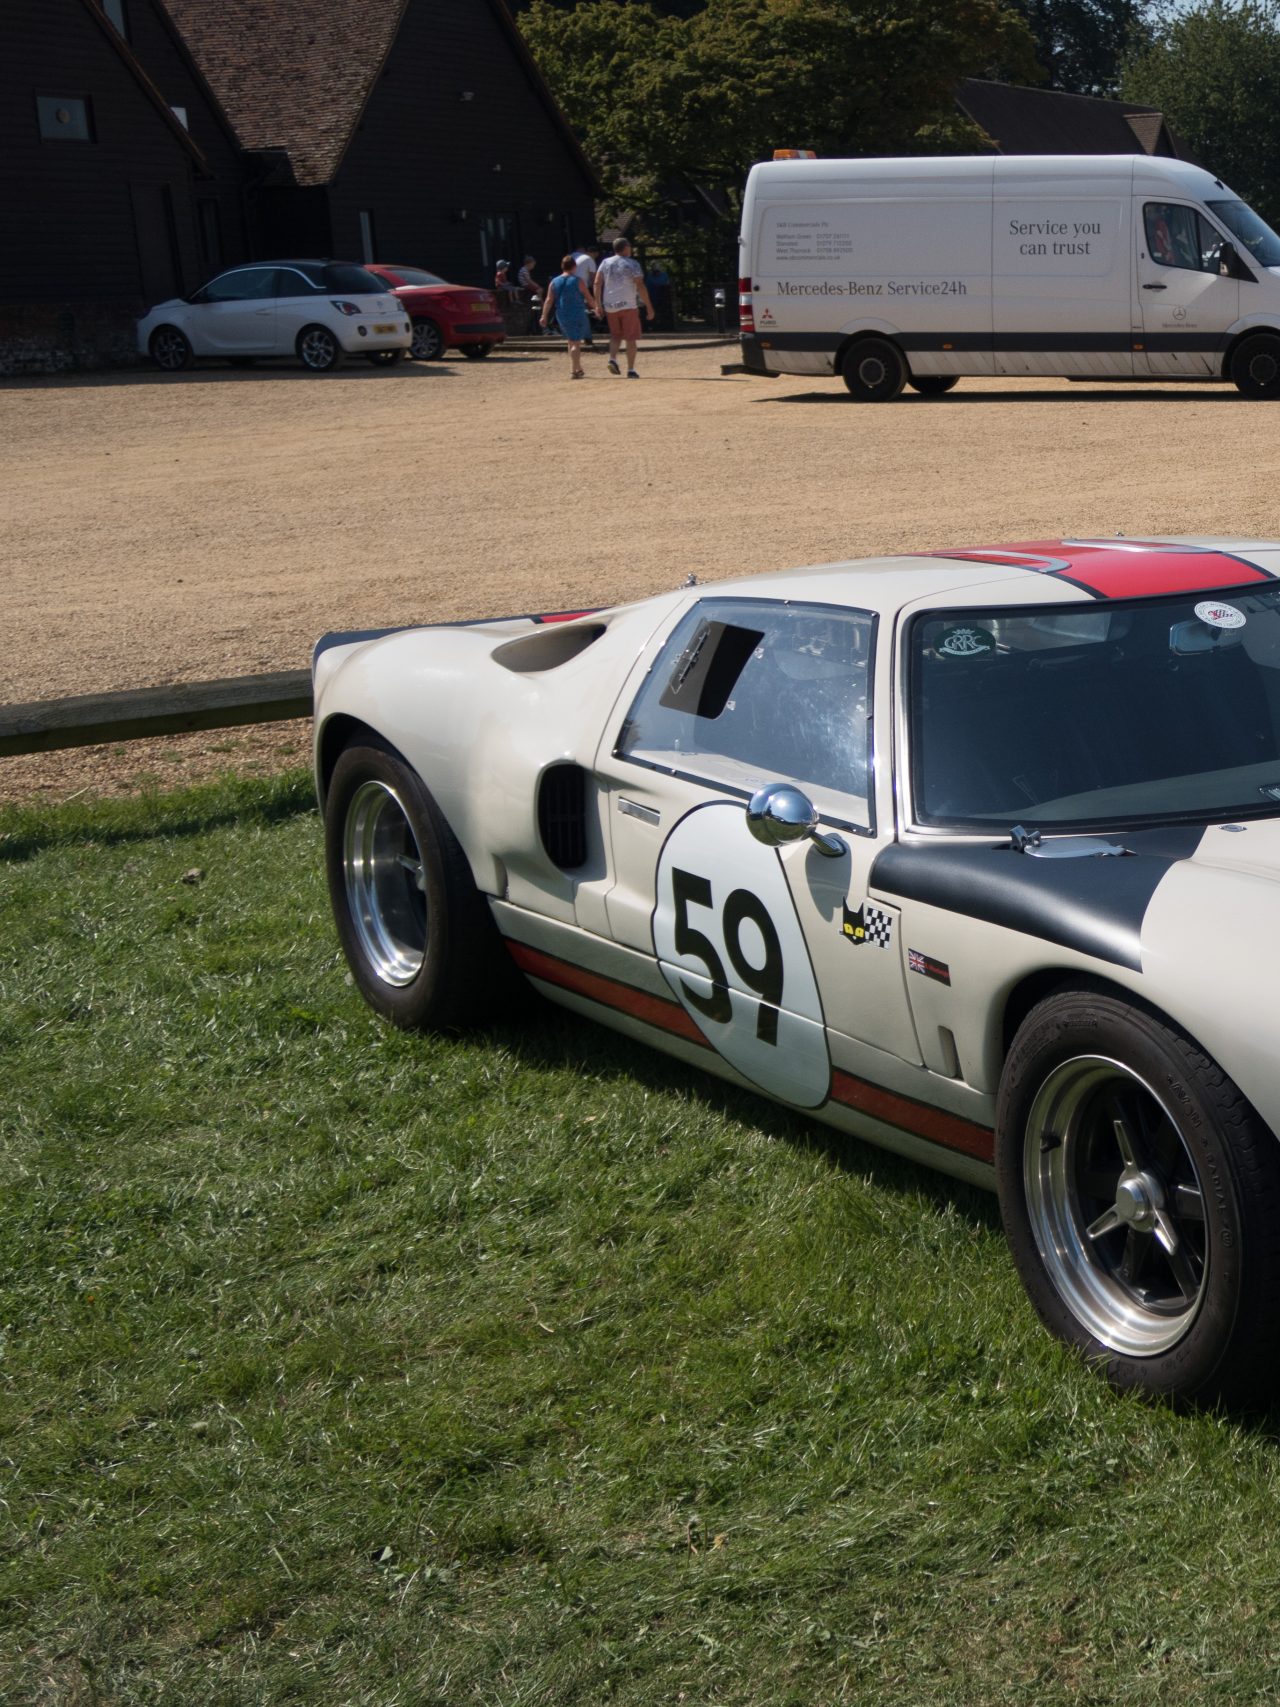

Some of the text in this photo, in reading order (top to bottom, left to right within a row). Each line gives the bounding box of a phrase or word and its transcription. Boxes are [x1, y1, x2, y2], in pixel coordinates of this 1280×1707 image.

[1009, 219, 1102, 239] Service you
[1019, 241, 1091, 256] can trust
[777, 281, 967, 296] Mercedes-Benz Service24h
[672, 866, 784, 1047] 59
